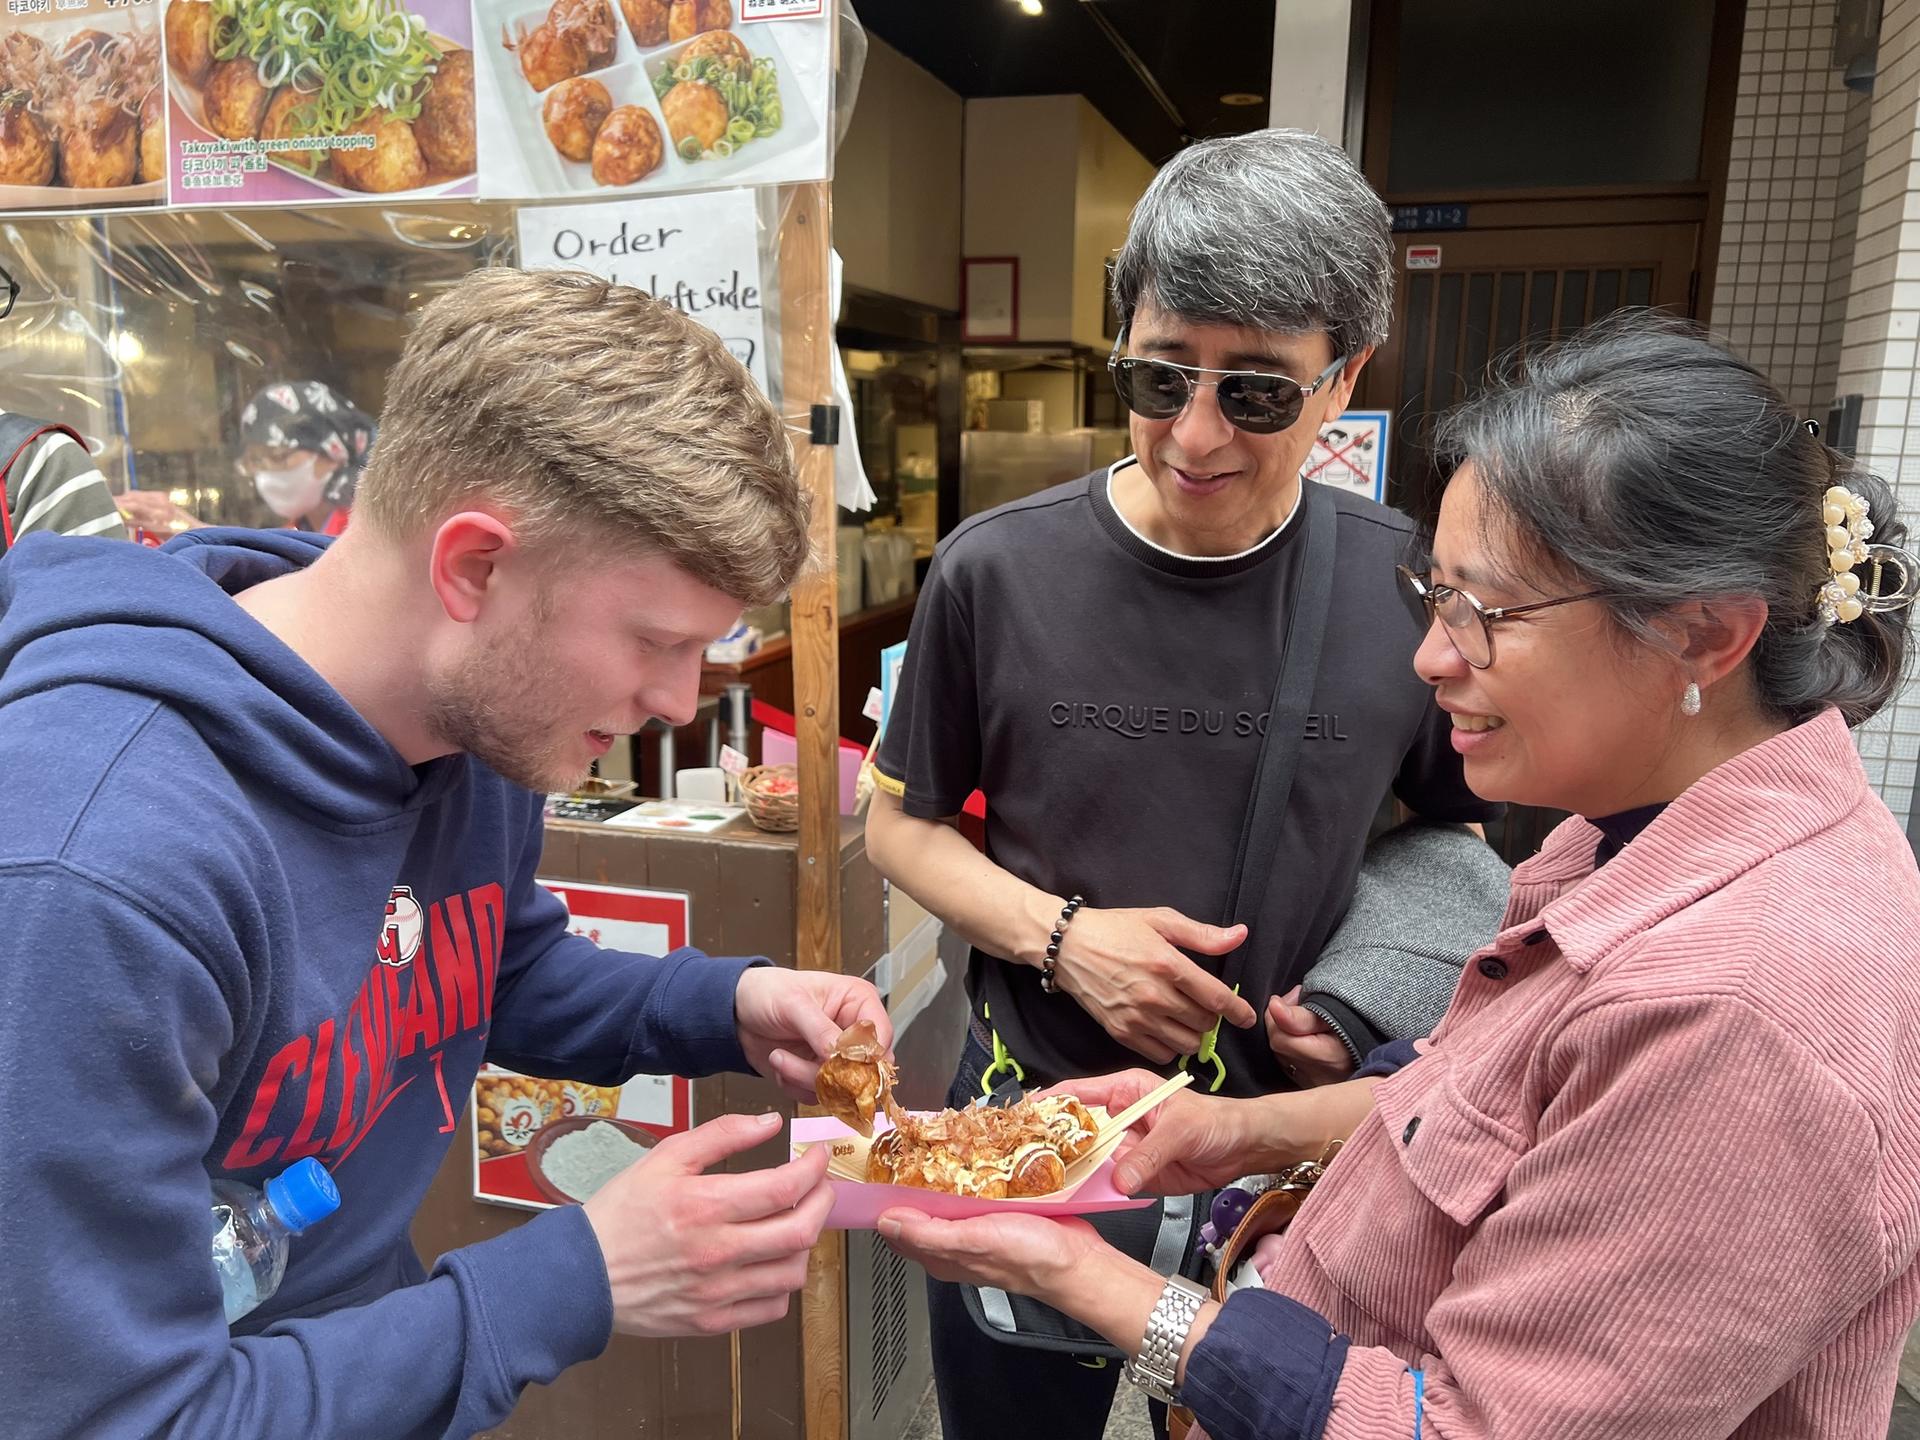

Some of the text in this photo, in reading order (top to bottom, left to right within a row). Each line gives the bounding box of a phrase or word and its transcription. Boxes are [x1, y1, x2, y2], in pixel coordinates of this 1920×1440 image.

[181, 134, 375, 154] Takoyaki with green onions topping
[1424, 208, 1461, 225] 21-2
[553, 222, 683, 260] Order
[705, 270, 761, 311] side
[1048, 701, 1349, 741] CIRQUE DU SOEIL
[222, 881, 505, 1170] CLEVEAND
